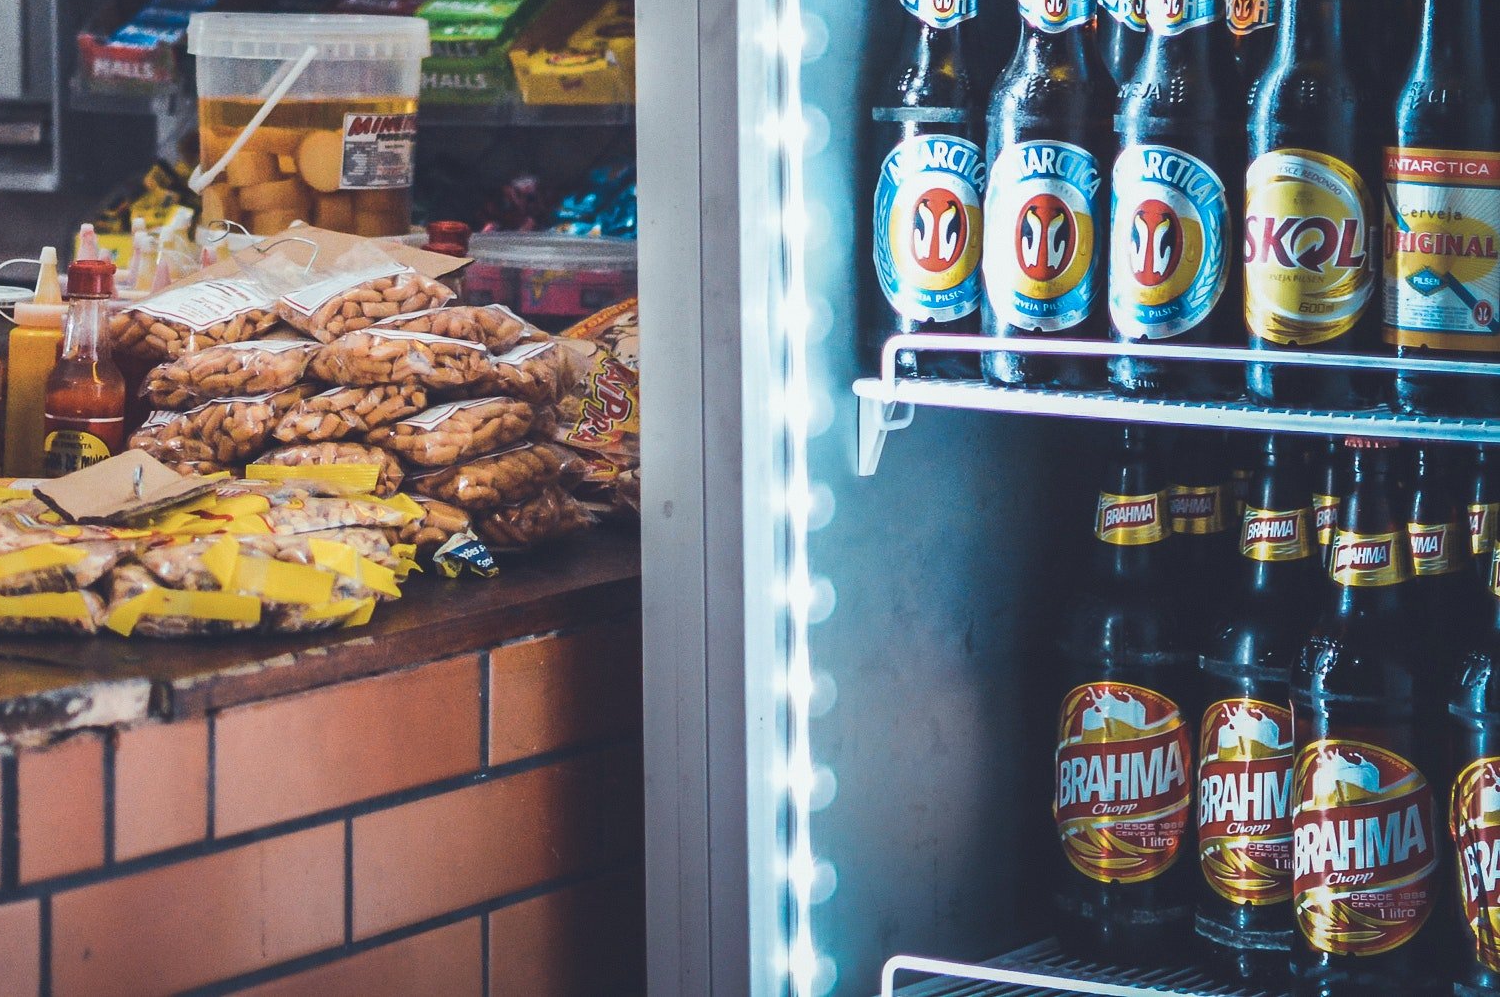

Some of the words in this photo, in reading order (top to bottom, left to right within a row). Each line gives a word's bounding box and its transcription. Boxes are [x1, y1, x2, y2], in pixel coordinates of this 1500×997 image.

[1388, 157, 1491, 176] ANTARCTICA
[1400, 205, 1463, 222] Cerveja
[1243, 215, 1367, 274] SKOL
[1384, 223, 1499, 260] ORIGINAL
[1412, 274, 1441, 287] PILSEN
[1104, 503, 1154, 527] BRAHMA
[1247, 518, 1295, 540] BRAHMA
[1059, 739, 1186, 809] BRAHMA
[1199, 766, 1293, 827] BRAHM
[1091, 802, 1138, 816] Chopp
[1115, 822, 1156, 831] DESDE
[1226, 822, 1271, 836] Chopp
[1115, 830, 1157, 838] CERVEJA
[1150, 836, 1176, 848] litro
[1248, 843, 1289, 852] DESDE
[1294, 803, 1427, 881] BRAHMA
[1324, 871, 1375, 886] Chopp
[1350, 893, 1394, 902] DESDE
[1350, 901, 1395, 909] CERVEJA
[1389, 908, 1417, 920] litro
